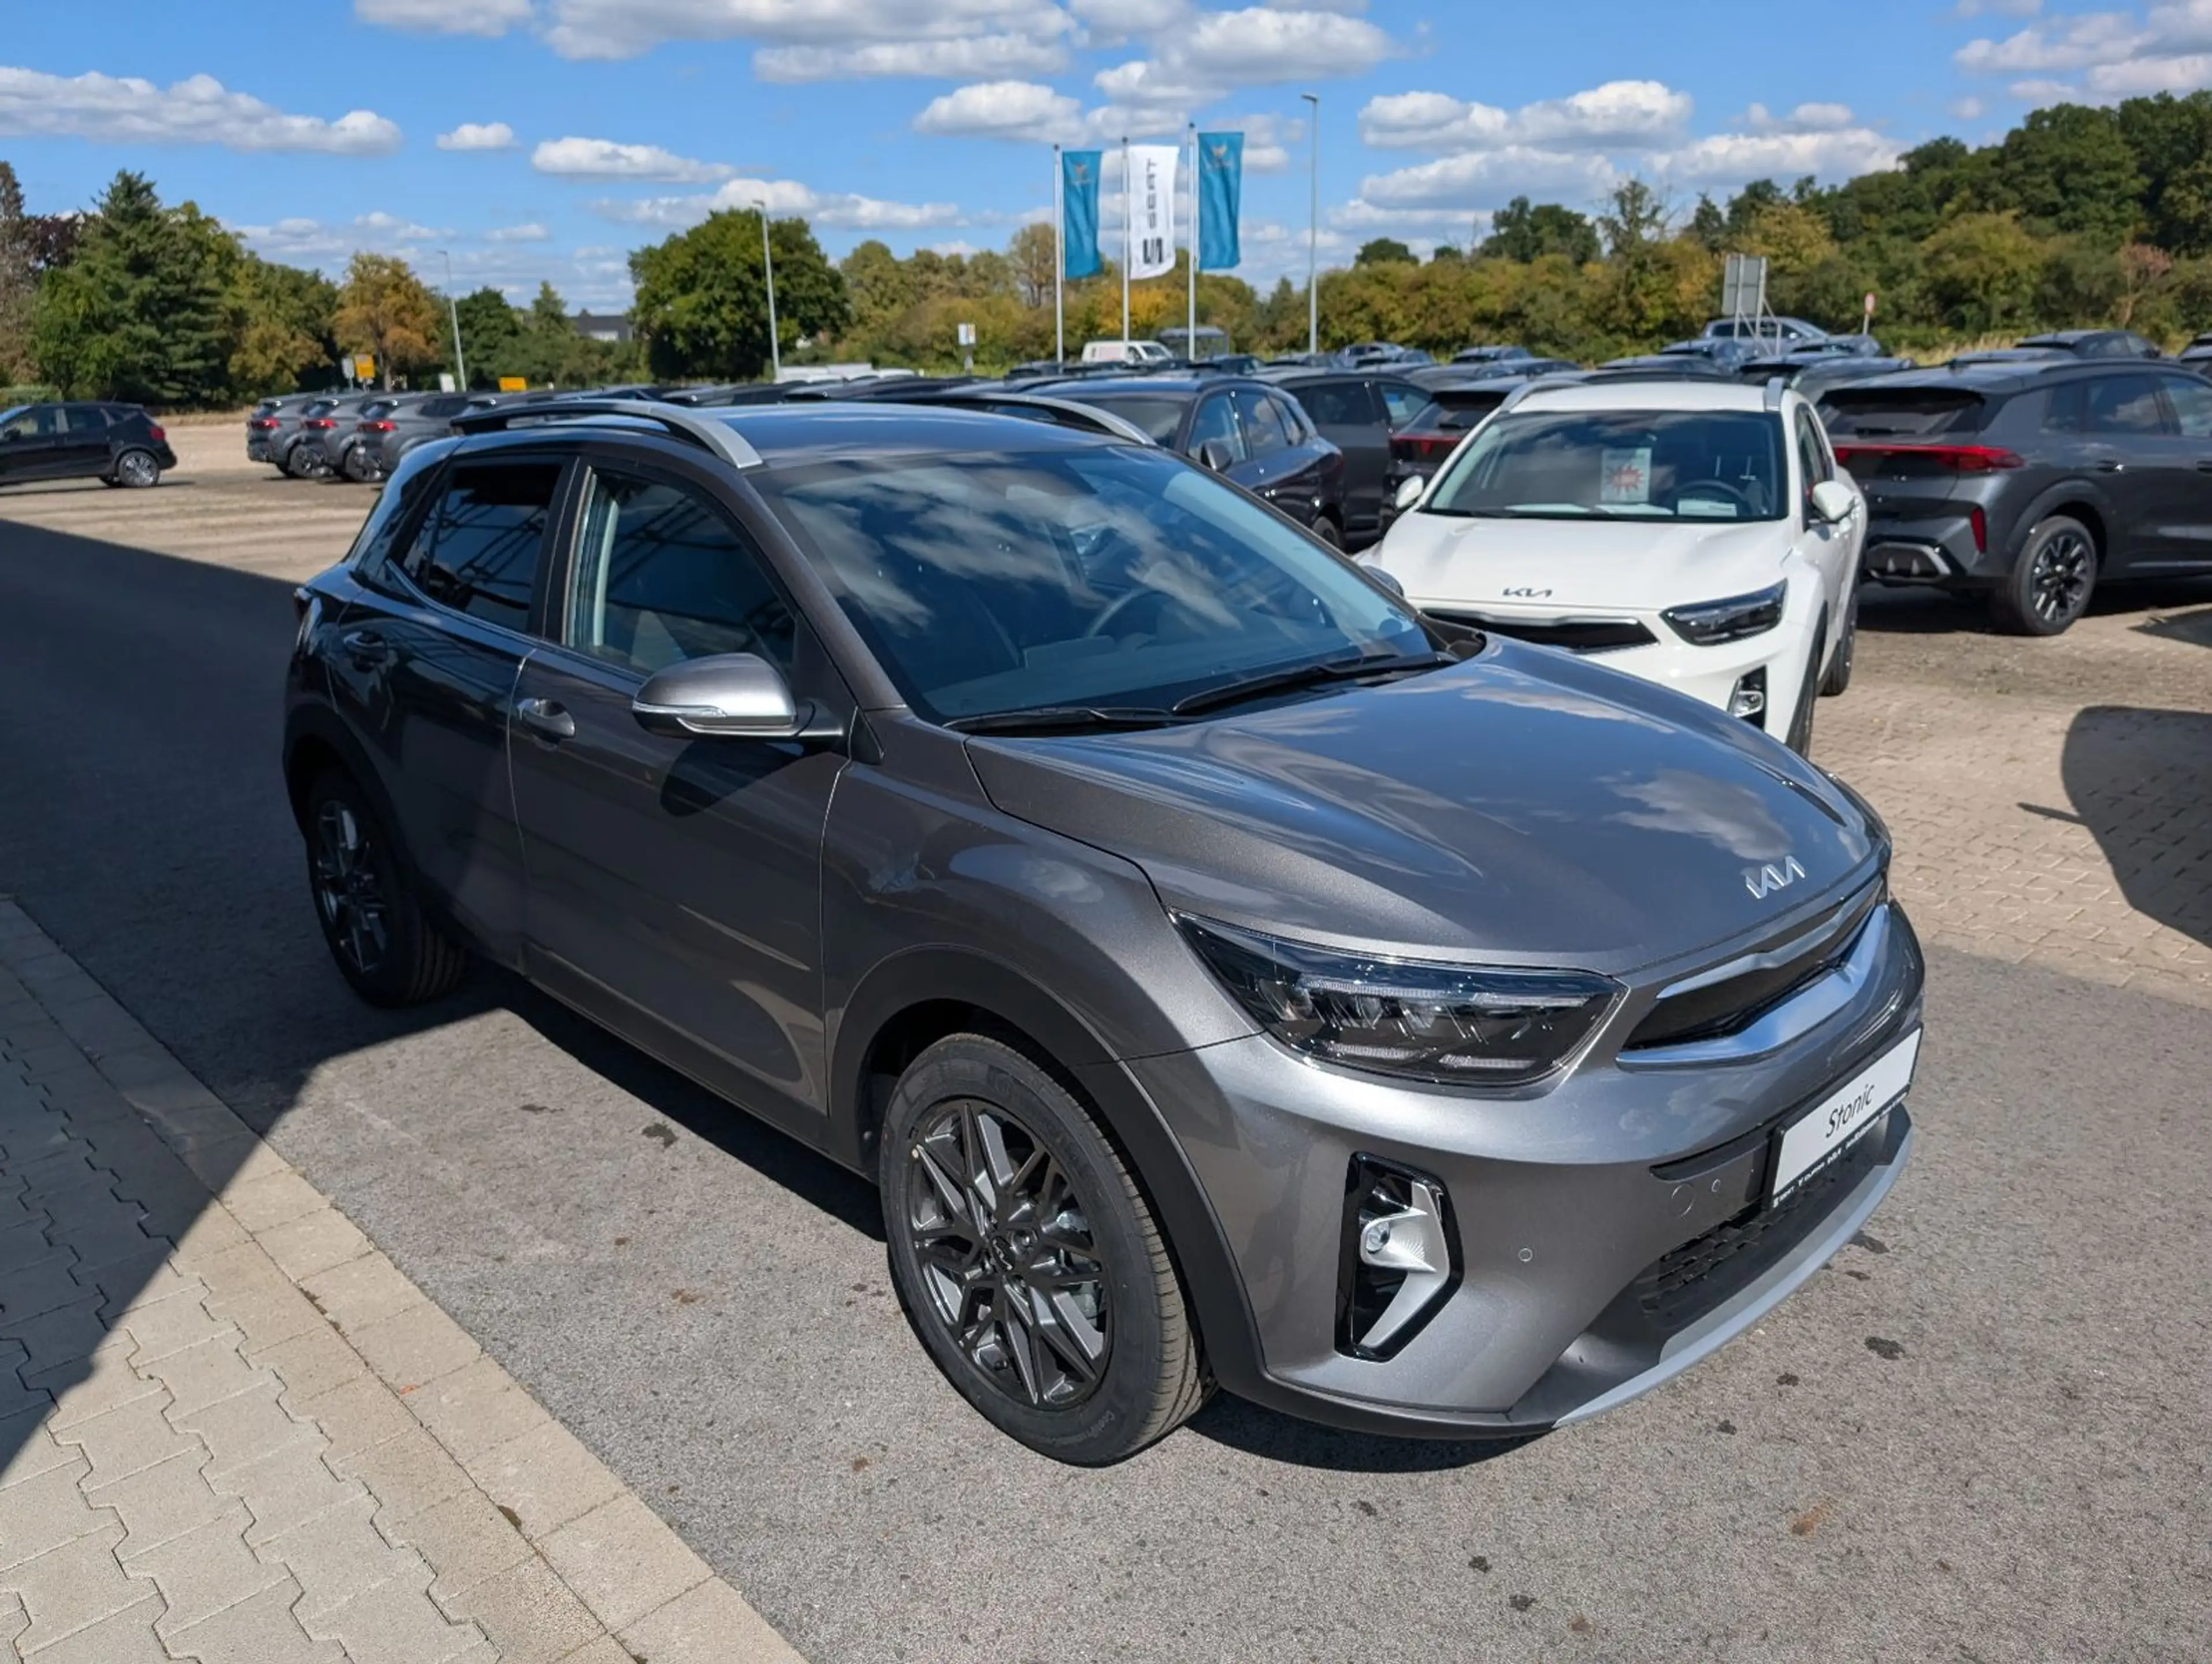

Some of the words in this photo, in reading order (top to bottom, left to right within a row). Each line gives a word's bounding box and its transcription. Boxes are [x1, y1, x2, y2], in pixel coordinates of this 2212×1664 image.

[1146, 158, 1158, 229] SEAT
[1502, 587, 1553, 597] KIA
[1745, 855, 1806, 900] KIA
[1825, 1083, 1875, 1139] Stonic
